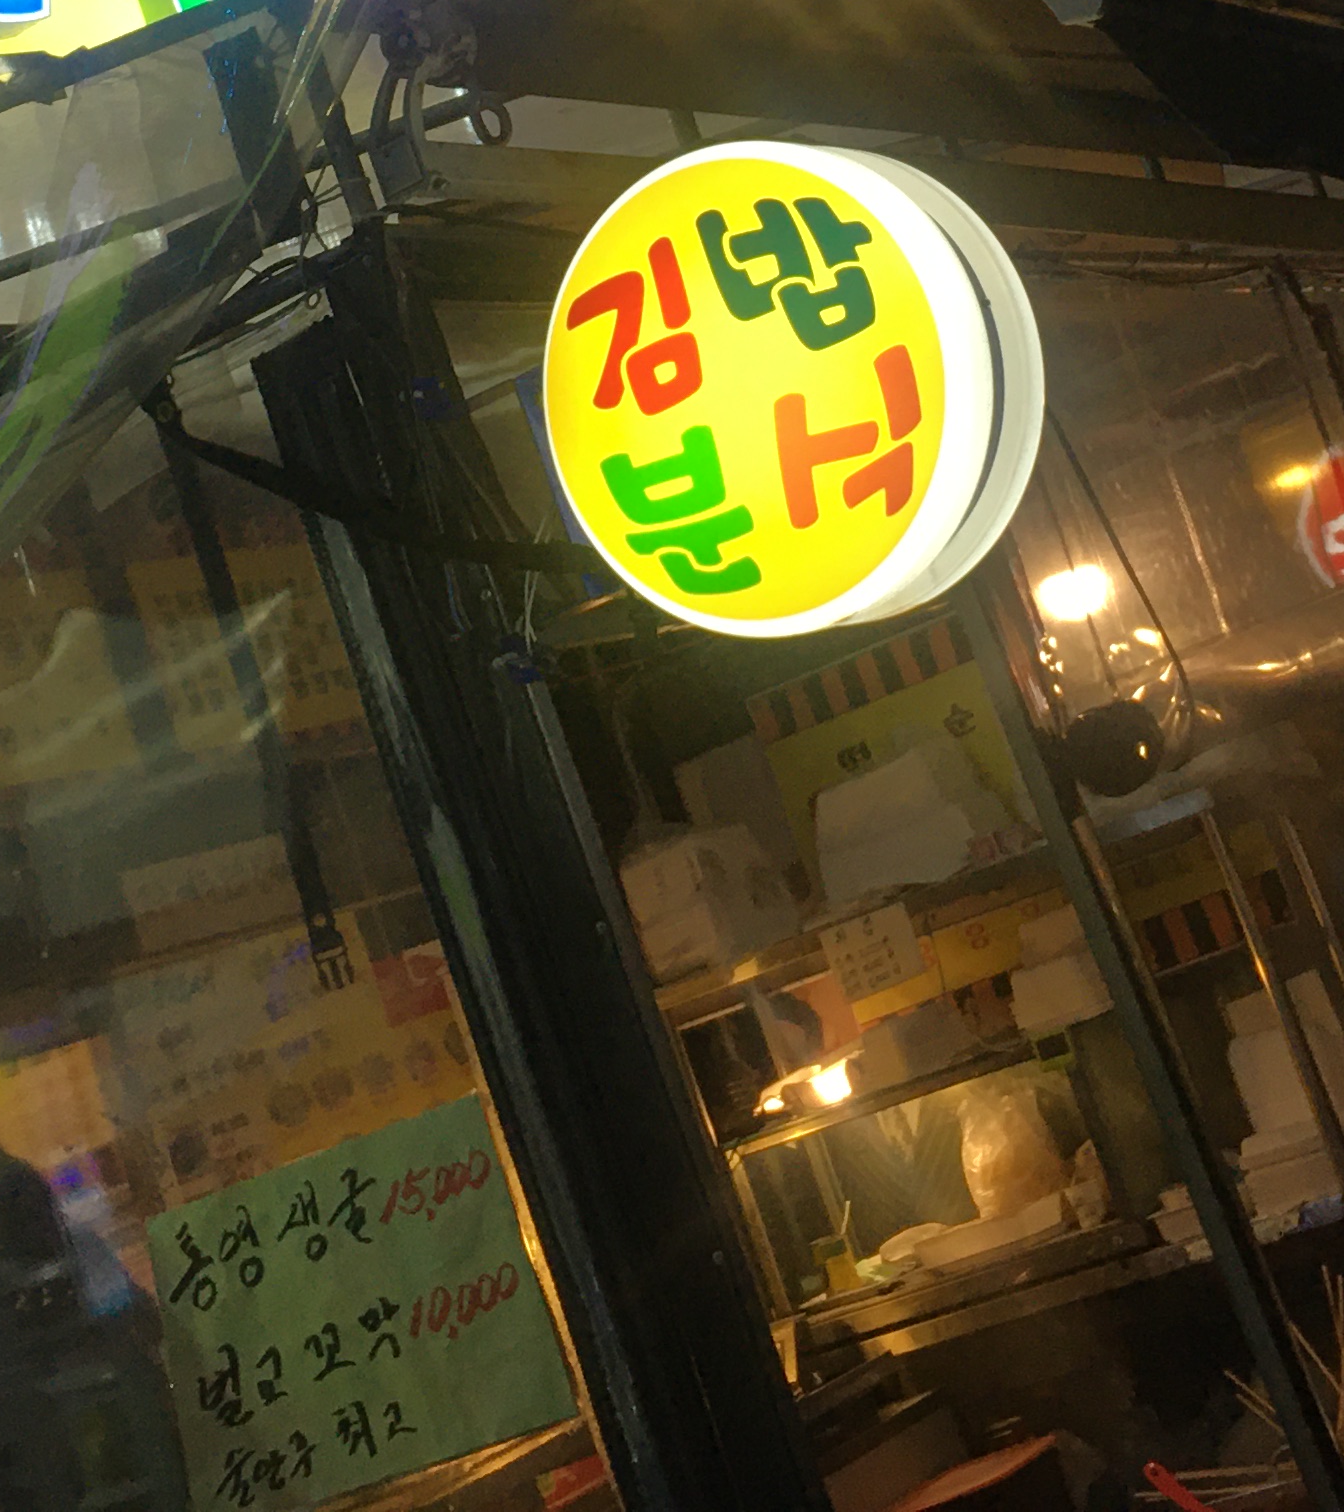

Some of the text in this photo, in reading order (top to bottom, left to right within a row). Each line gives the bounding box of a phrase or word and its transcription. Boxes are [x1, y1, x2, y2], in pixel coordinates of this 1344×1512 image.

[566, 196, 877, 417] 김밥
[599, 344, 923, 596] 분식
[168, 1149, 492, 1312] 통영 생굴 15,000
[304, 1296, 402, 1382] 꼬막
[408, 1261, 521, 1341] 10,000
